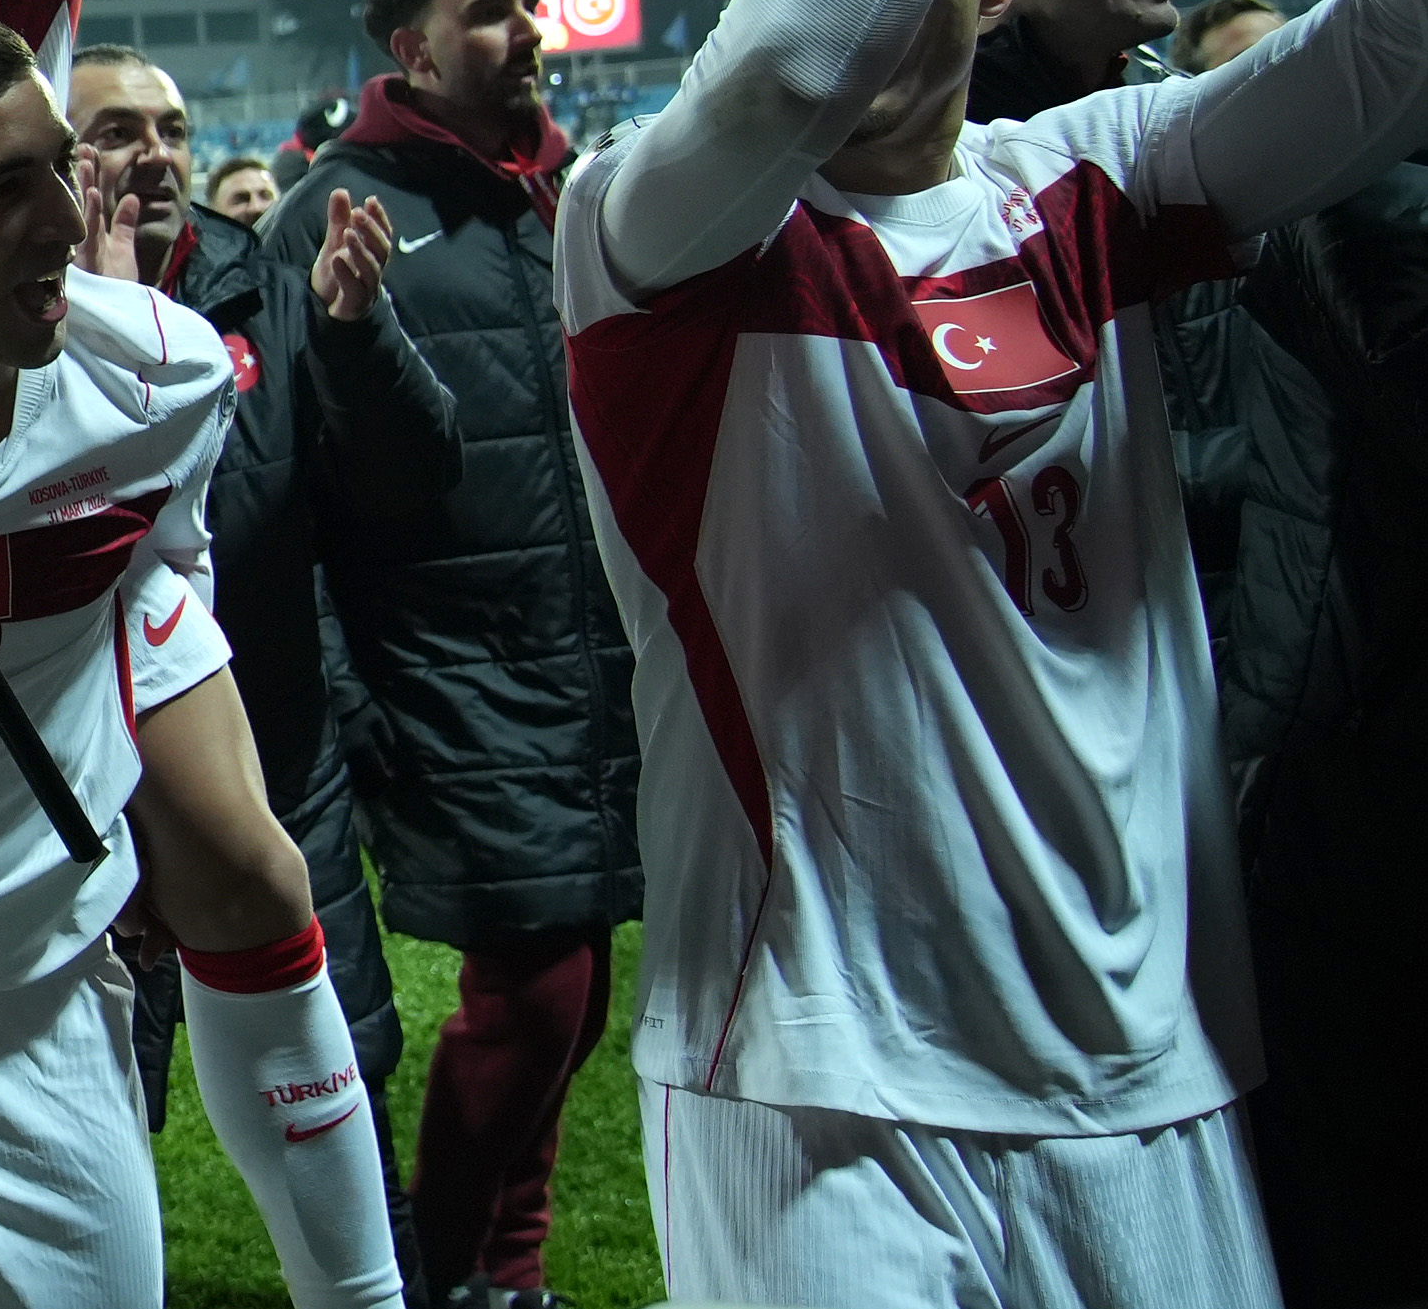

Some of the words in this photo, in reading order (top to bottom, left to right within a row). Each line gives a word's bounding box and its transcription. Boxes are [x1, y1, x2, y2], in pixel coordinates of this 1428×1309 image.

[47, 509, 59, 524] 31
[59, 499, 85, 521] MART
[85, 492, 107, 512] 2026
[963, 465, 1089, 617] 13
